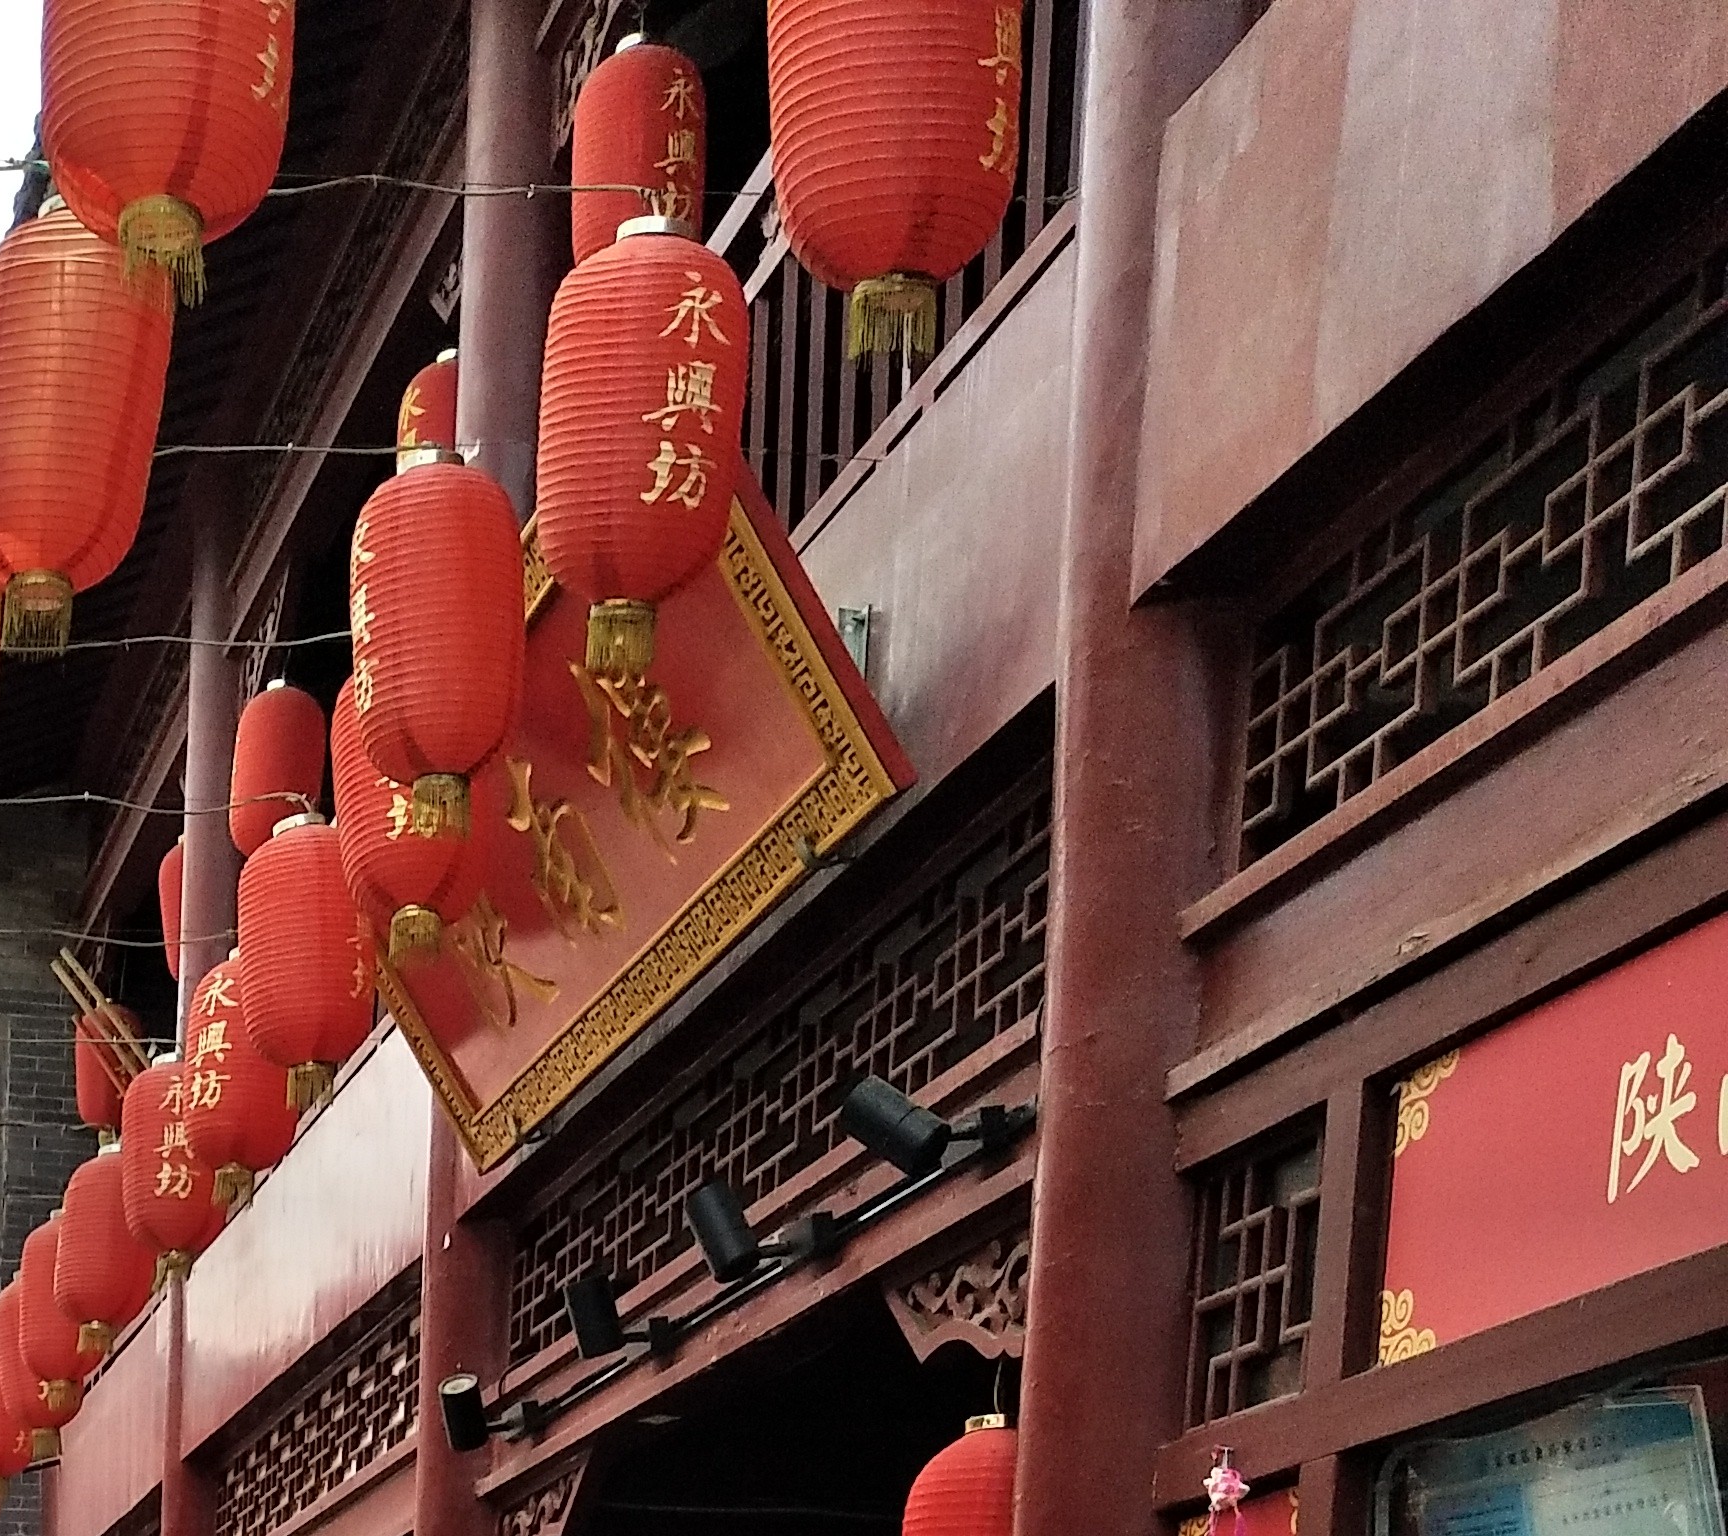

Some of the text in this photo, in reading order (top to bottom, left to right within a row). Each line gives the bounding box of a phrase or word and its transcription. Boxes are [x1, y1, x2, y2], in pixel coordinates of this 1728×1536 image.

[640, 271, 732, 510] 永興坊
[187, 972, 239, 1110] 永興坊
[152, 1074, 201, 1200] 永興坊
[1608, 1033, 1728, 1204] 陕
